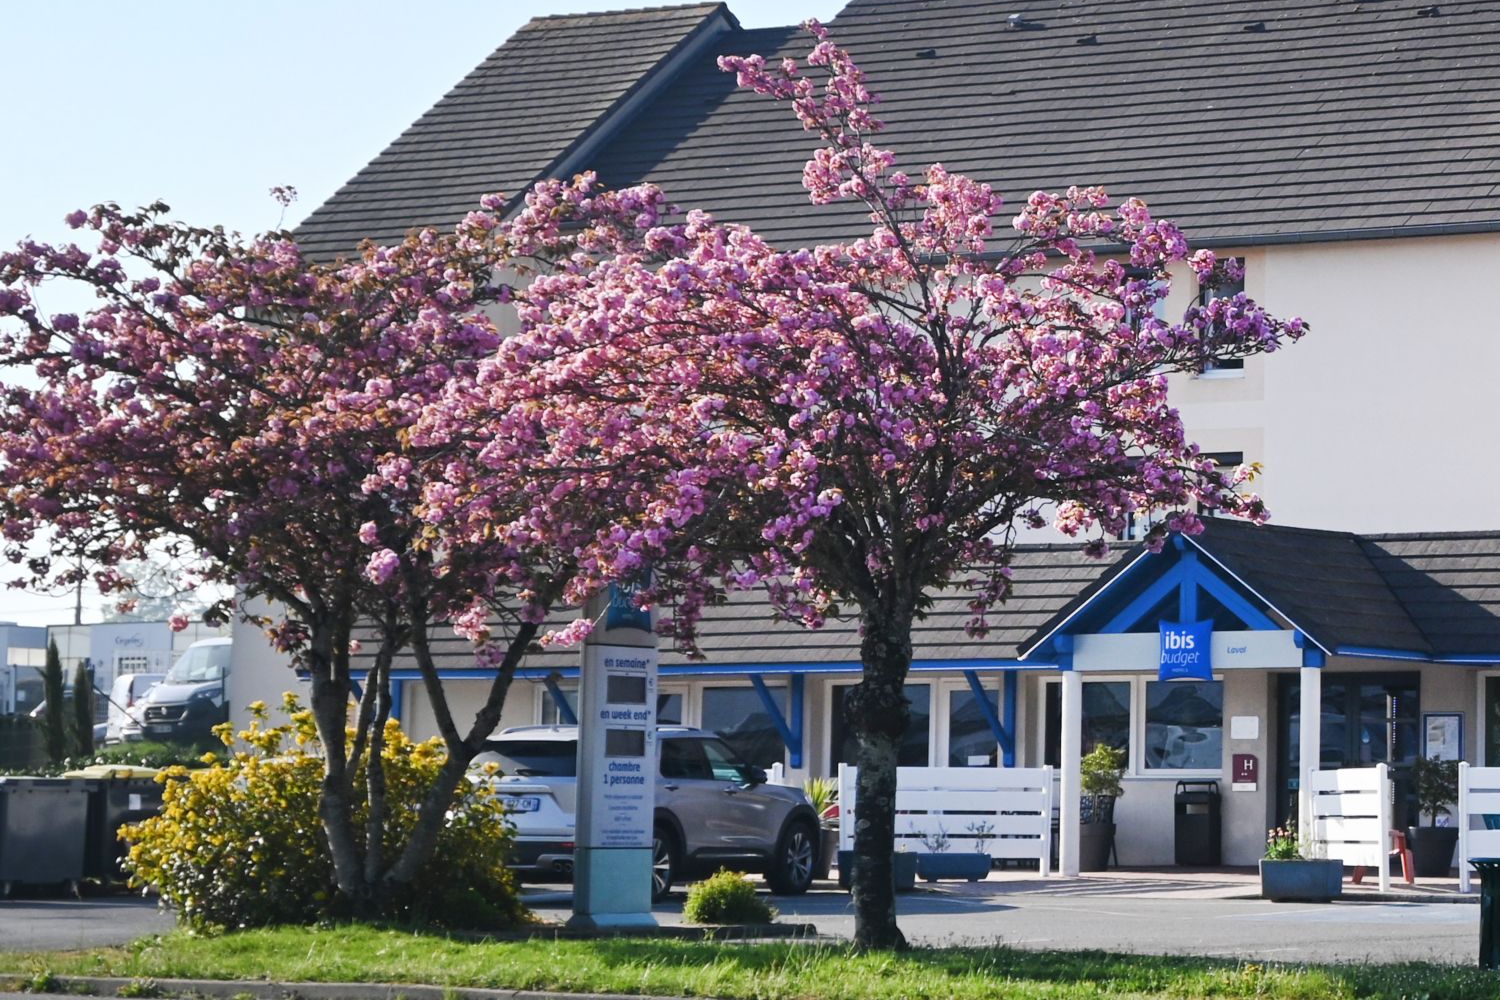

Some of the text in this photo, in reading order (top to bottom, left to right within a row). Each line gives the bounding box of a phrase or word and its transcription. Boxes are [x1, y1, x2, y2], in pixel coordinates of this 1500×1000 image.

[1165, 630, 1195, 649] ibis
[1227, 646, 1247, 654] Laval
[604, 659, 614, 667] en
[1161, 650, 1200, 667] budget
[600, 710, 610, 718] en
[611, 709, 632, 720] week
[608, 762, 640, 772] chambre
[1244, 759, 1253, 770] H
[603, 774, 645, 787] 1 personne
